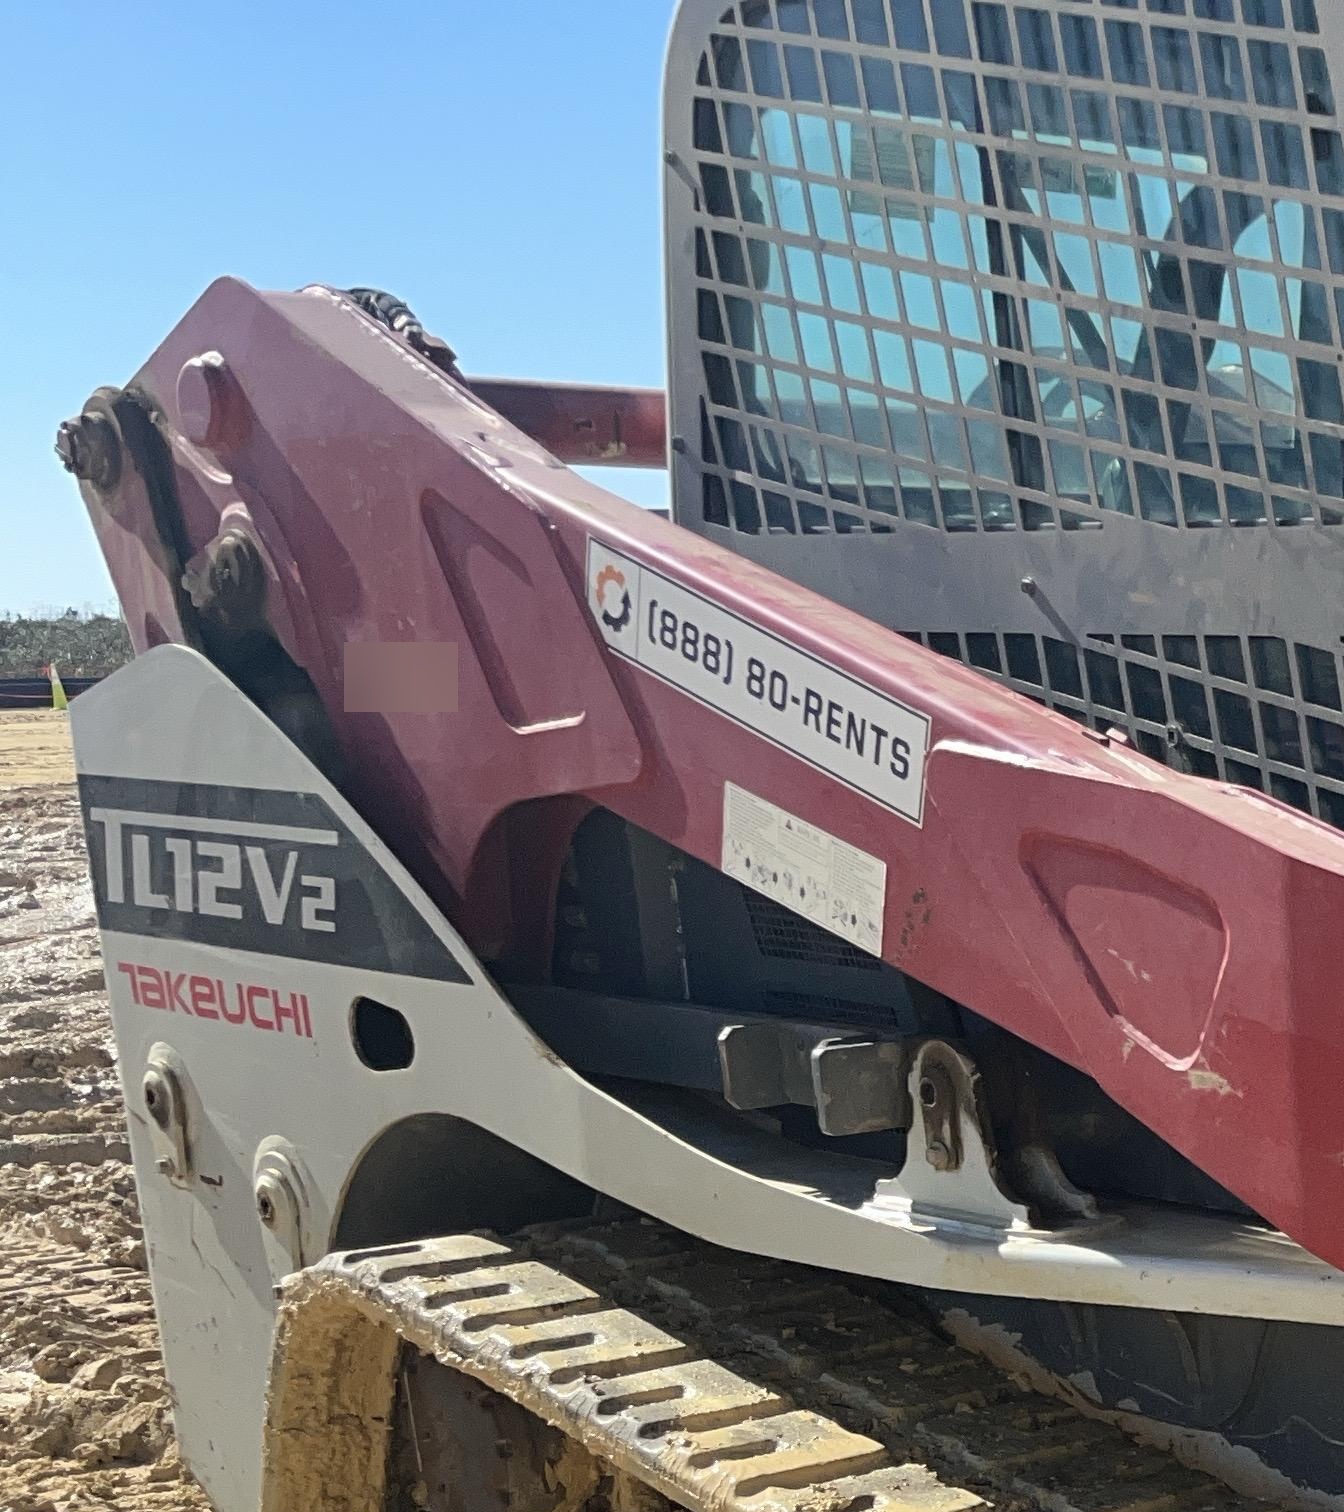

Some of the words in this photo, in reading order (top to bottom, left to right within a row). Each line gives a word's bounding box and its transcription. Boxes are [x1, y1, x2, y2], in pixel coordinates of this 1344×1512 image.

[649, 599, 733, 685] (888)
[745, 656, 911, 780] 80-RENTS
[89, 806, 339, 933] TL12V2
